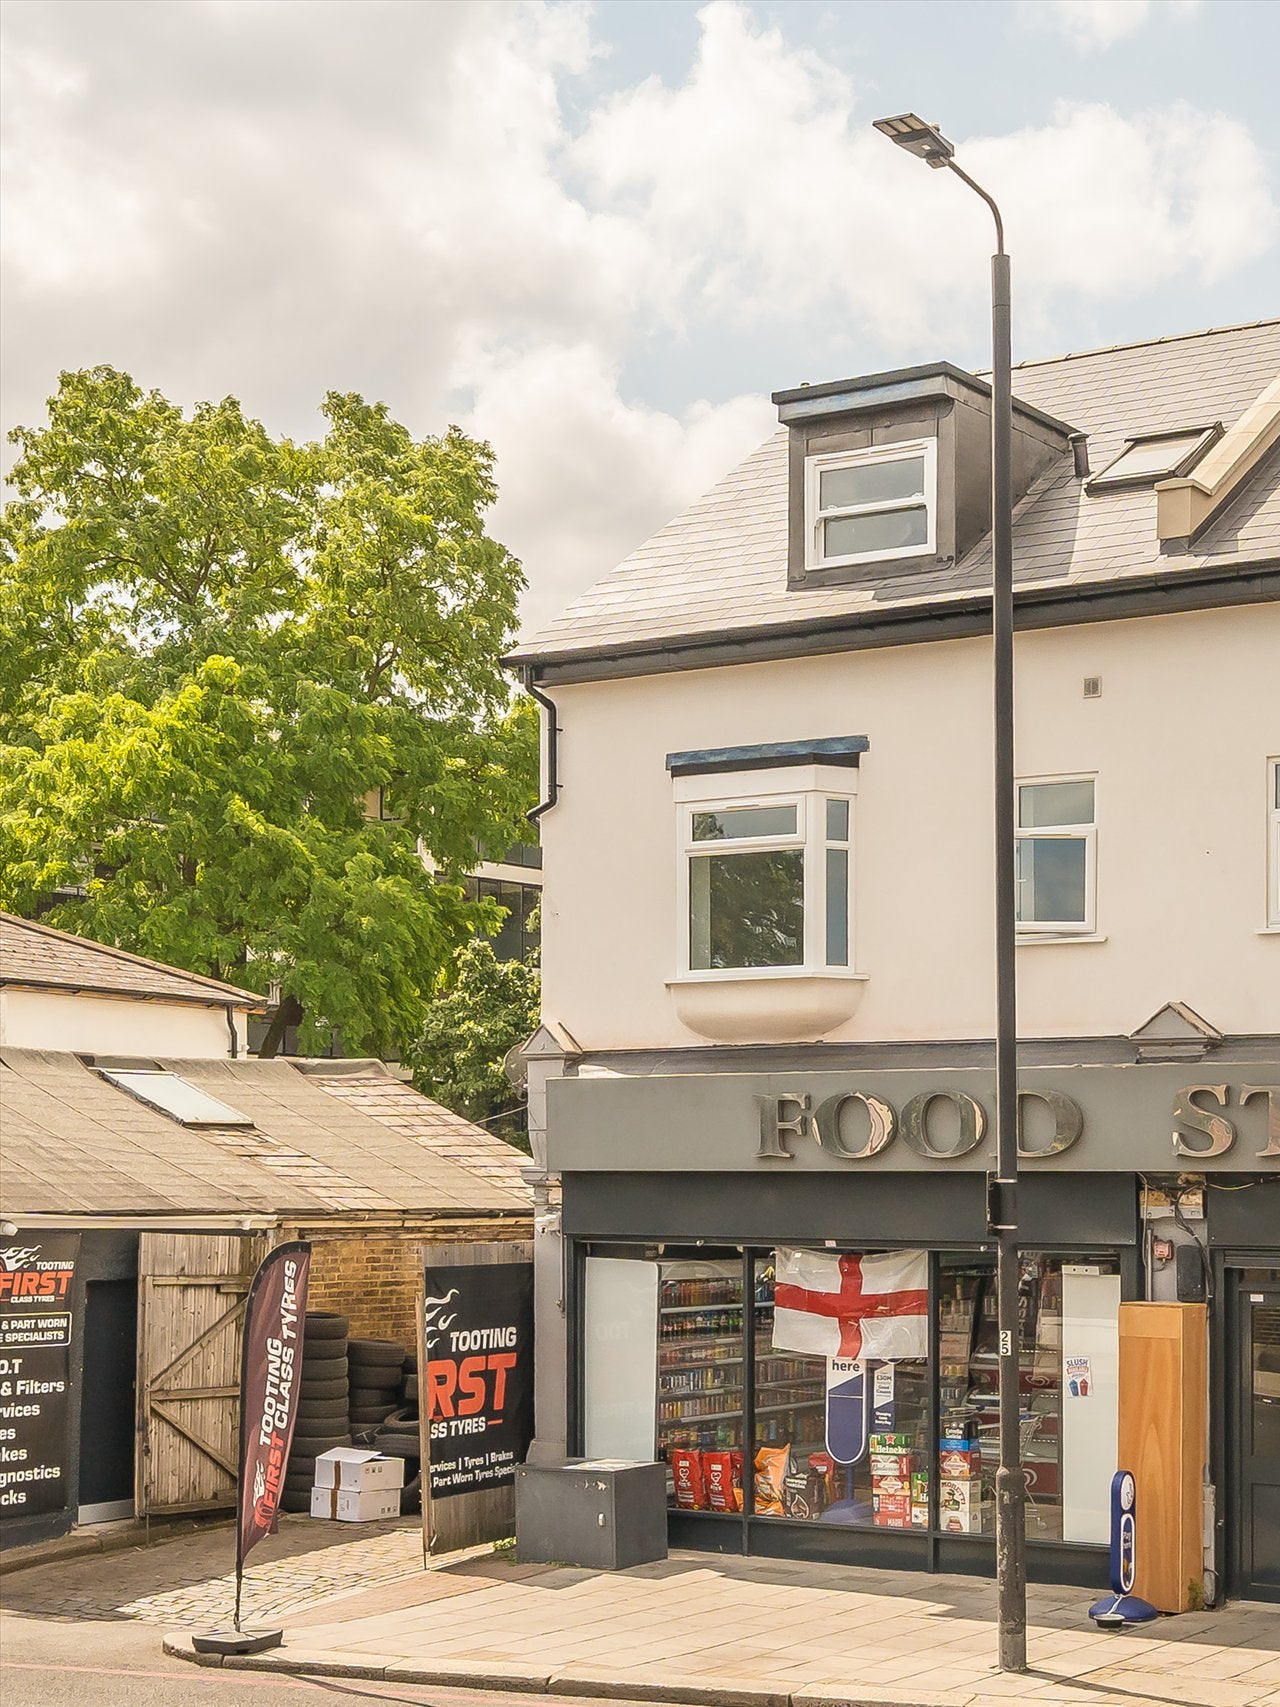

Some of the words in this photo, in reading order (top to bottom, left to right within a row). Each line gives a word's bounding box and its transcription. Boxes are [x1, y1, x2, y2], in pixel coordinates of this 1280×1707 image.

[753, 1091, 1084, 1160] FOOD
[36, 1261, 75, 1271] TOOTING
[10, 1295, 33, 1303] CLASS
[33, 1295, 55, 1303] TYRES
[280, 1259, 298, 1341] TYRES
[2, 1320, 9, 1330] &
[11, 1319, 36, 1330] PART
[38, 1318, 68, 1328] WORN
[5, 1330, 65, 1343] SPECIALISTS
[450, 1326, 517, 1352] TOOTING
[832, 1360, 860, 1371] here
[1066, 1358, 1088, 1367] SLUSH
[1, 1381, 12, 1397] &
[16, 1379, 65, 1396] Filters
[260, 1337, 283, 1446] TOOTING
[274, 1346, 295, 1430] CLASS
[428, 1353, 517, 1420] RST
[430, 1421, 448, 1439] SS
[450, 1416, 486, 1437] TYRES
[0, 1447, 28, 1462] kes
[464, 1456, 484, 1469] Tyres
[490, 1450, 514, 1463] Brakes
[263, 1430, 285, 1505] FIRST
[433, 1475, 452, 1488] Part
[452, 1472, 473, 1484] Worn
[474, 1469, 494, 1482] Tyres
